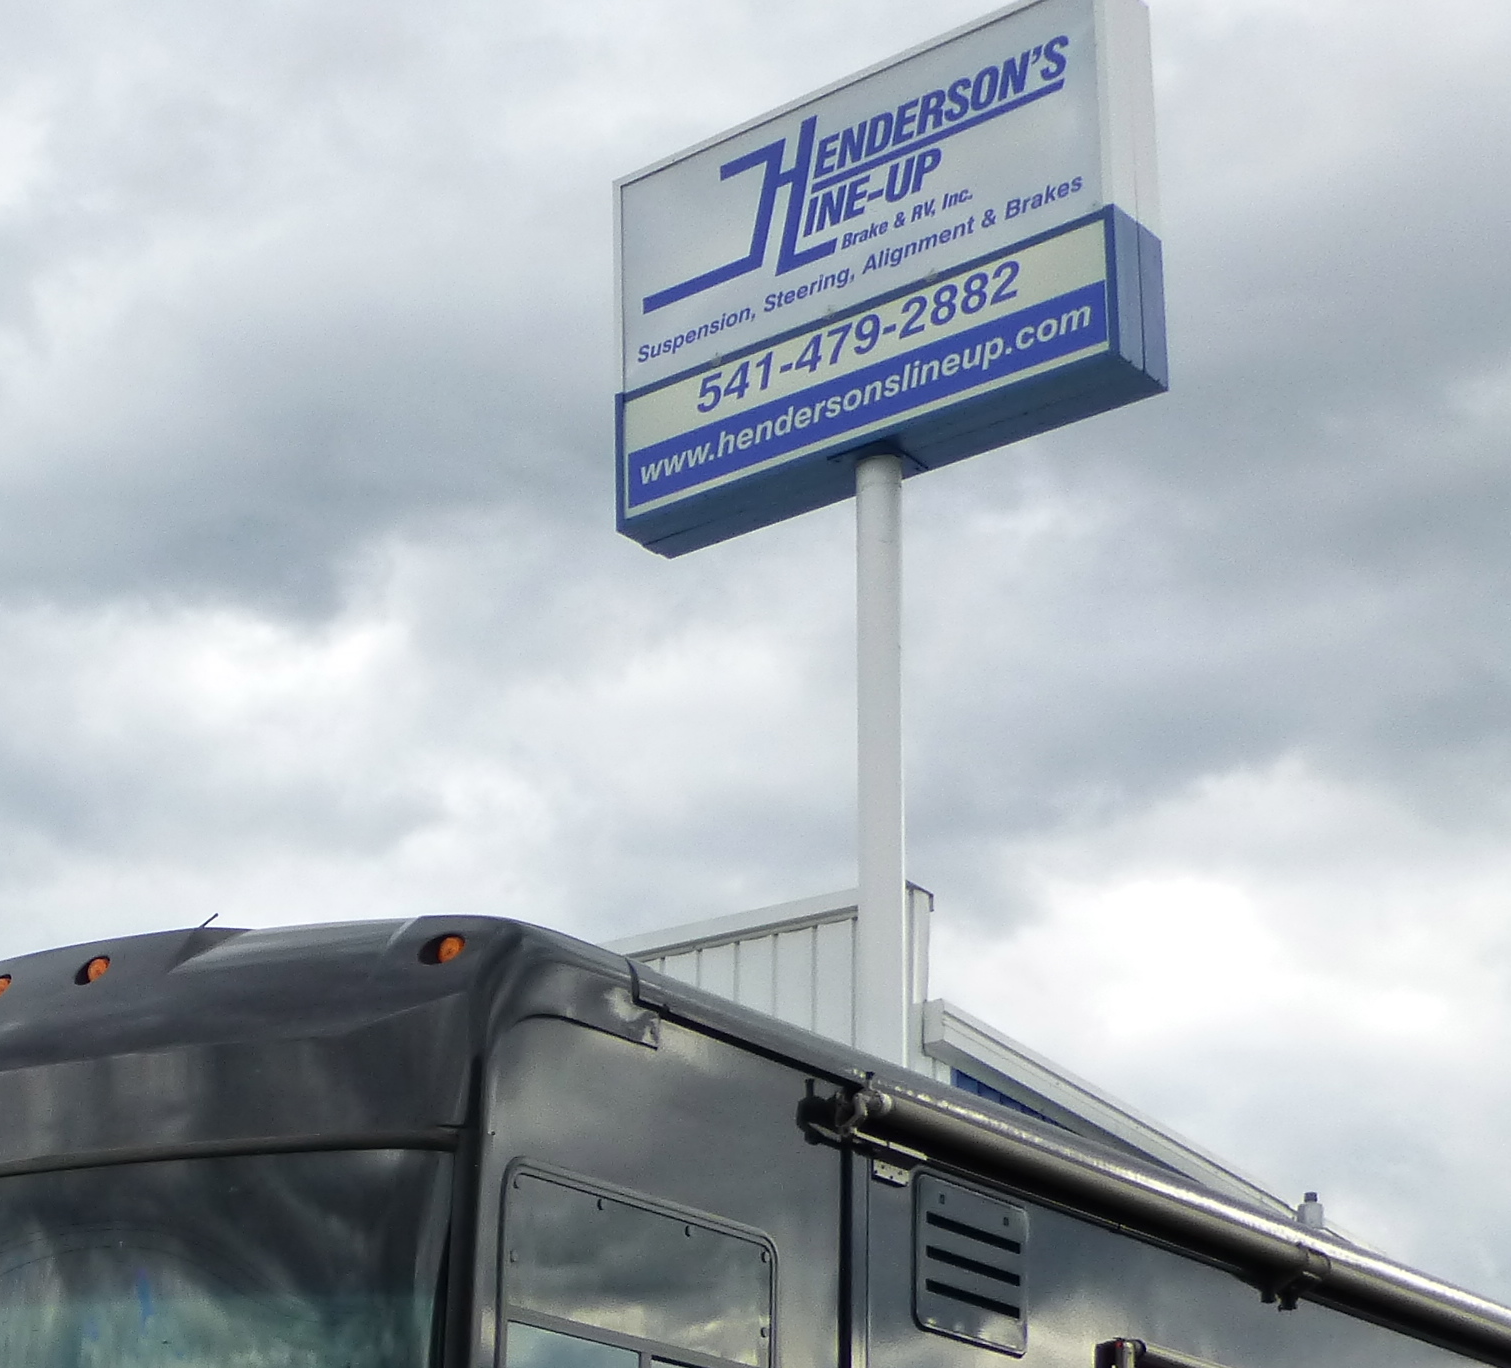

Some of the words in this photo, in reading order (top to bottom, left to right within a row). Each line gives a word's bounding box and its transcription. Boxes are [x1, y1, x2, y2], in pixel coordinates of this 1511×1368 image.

[637, 306, 757, 363] Suspension,
[763, 269, 855, 314] Steering,
[862, 216, 975, 275] Alignment
[980, 209, 997, 228] &
[1005, 176, 1083, 220] Brakes
[776, 148, 942, 276] LINE-UP
[841, 219, 888, 250] Brake
[893, 211, 905, 227] &
[911, 199, 936, 223] RV,
[943, 187, 973, 210] Inc.
[640, 306, 1091, 485] www.hendersonslineup.com
[696, 260, 1021, 413] 541-479-2882
